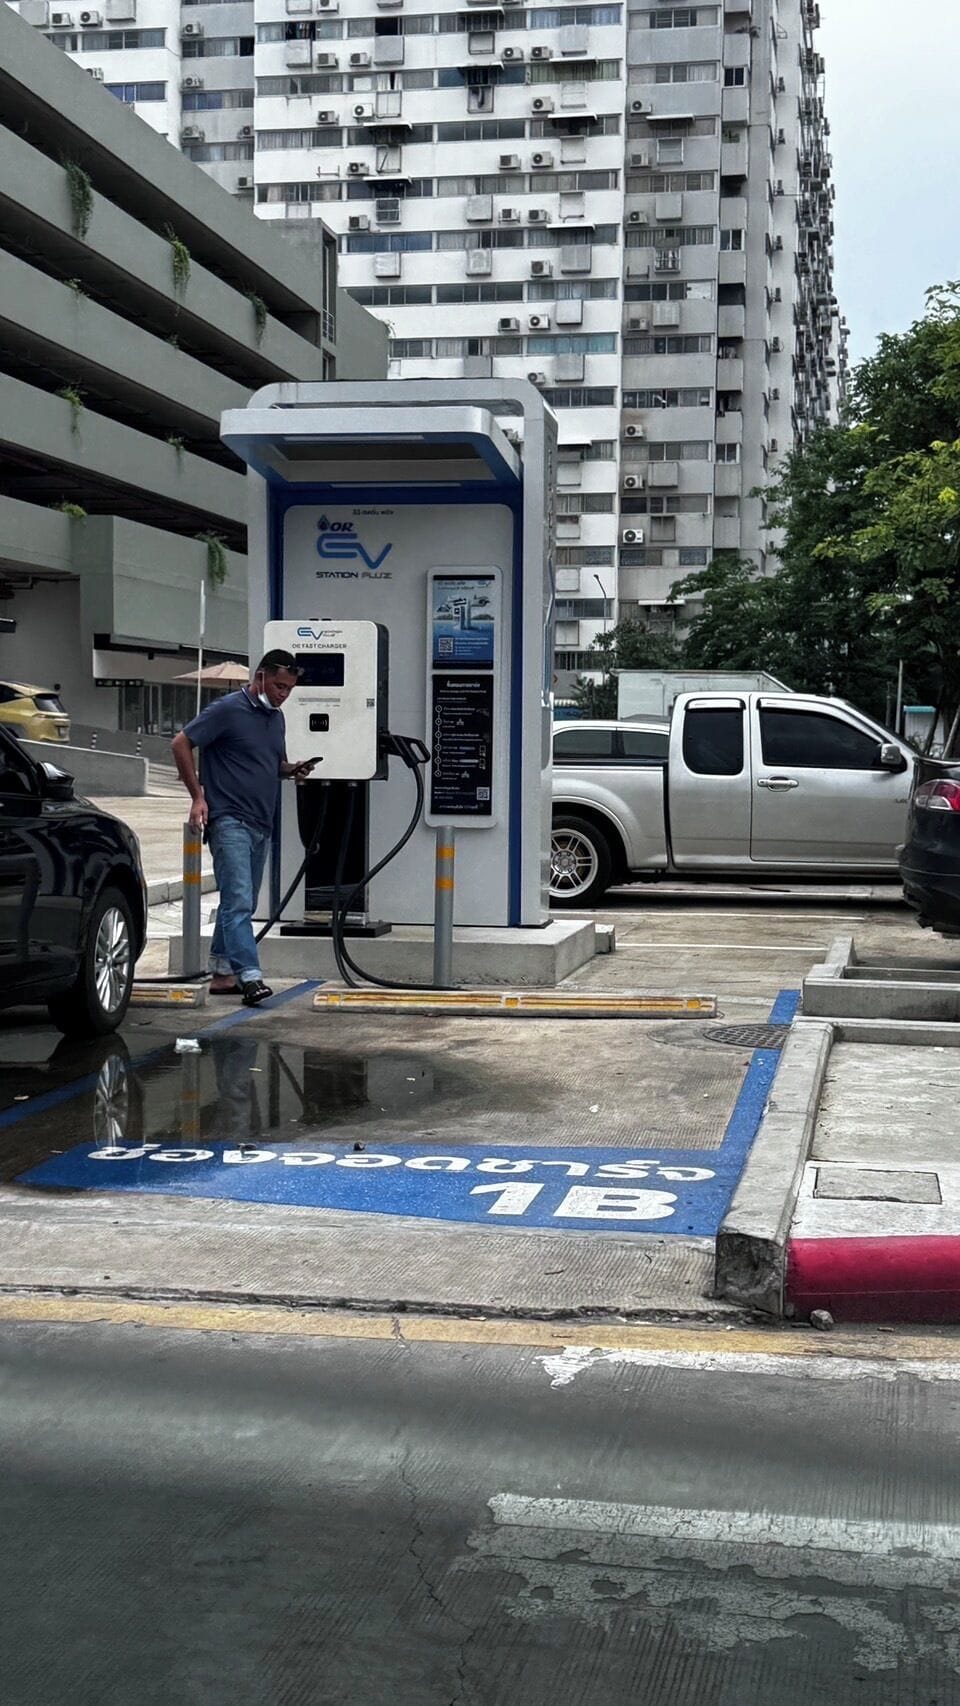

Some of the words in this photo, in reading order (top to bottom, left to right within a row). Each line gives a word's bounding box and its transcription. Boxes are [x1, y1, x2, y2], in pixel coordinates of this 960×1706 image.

[330, 522, 354, 532] OR
[317, 533, 393, 570] EV
[316, 571, 359, 579] STATION
[297, 627, 323, 640] EV
[87, 1143, 717, 1182] ช่องจอดชาร์จ
[469, 1181, 678, 1220] 1B
